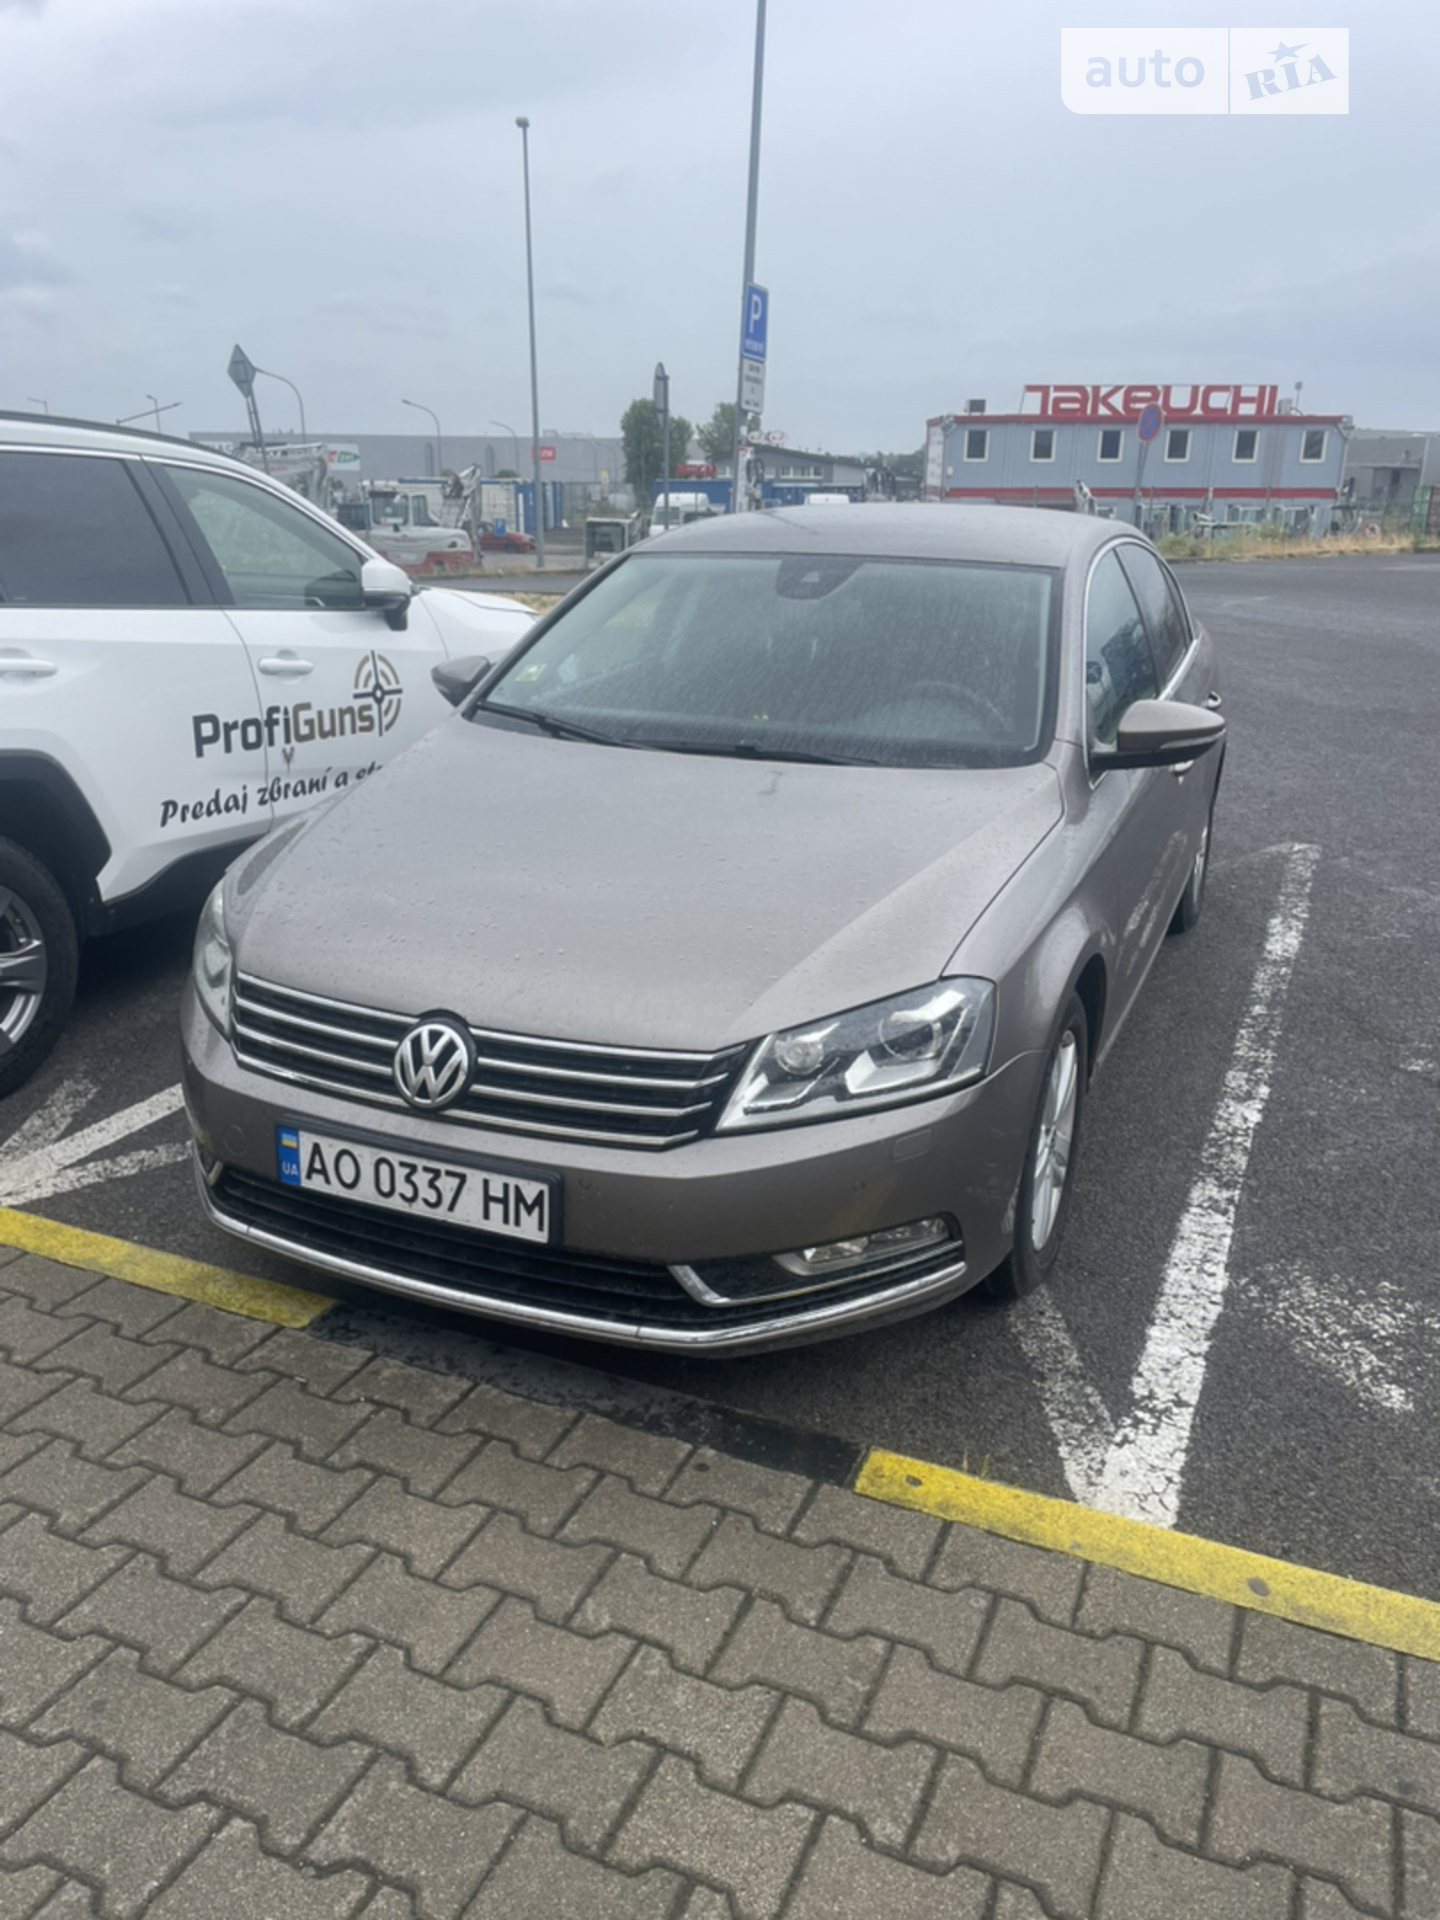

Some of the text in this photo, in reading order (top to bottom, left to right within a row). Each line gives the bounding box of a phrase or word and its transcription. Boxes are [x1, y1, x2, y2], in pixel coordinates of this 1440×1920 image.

[749, 294, 763, 334] P
[192, 702, 376, 758] ProfiGuns
[160, 784, 249, 828] Predaj
[256, 766, 333, 806] zbraní
[333, 770, 349, 788] a
[282, 1162, 299, 1176] UA
[305, 1141, 546, 1232] AO 0337 HM
